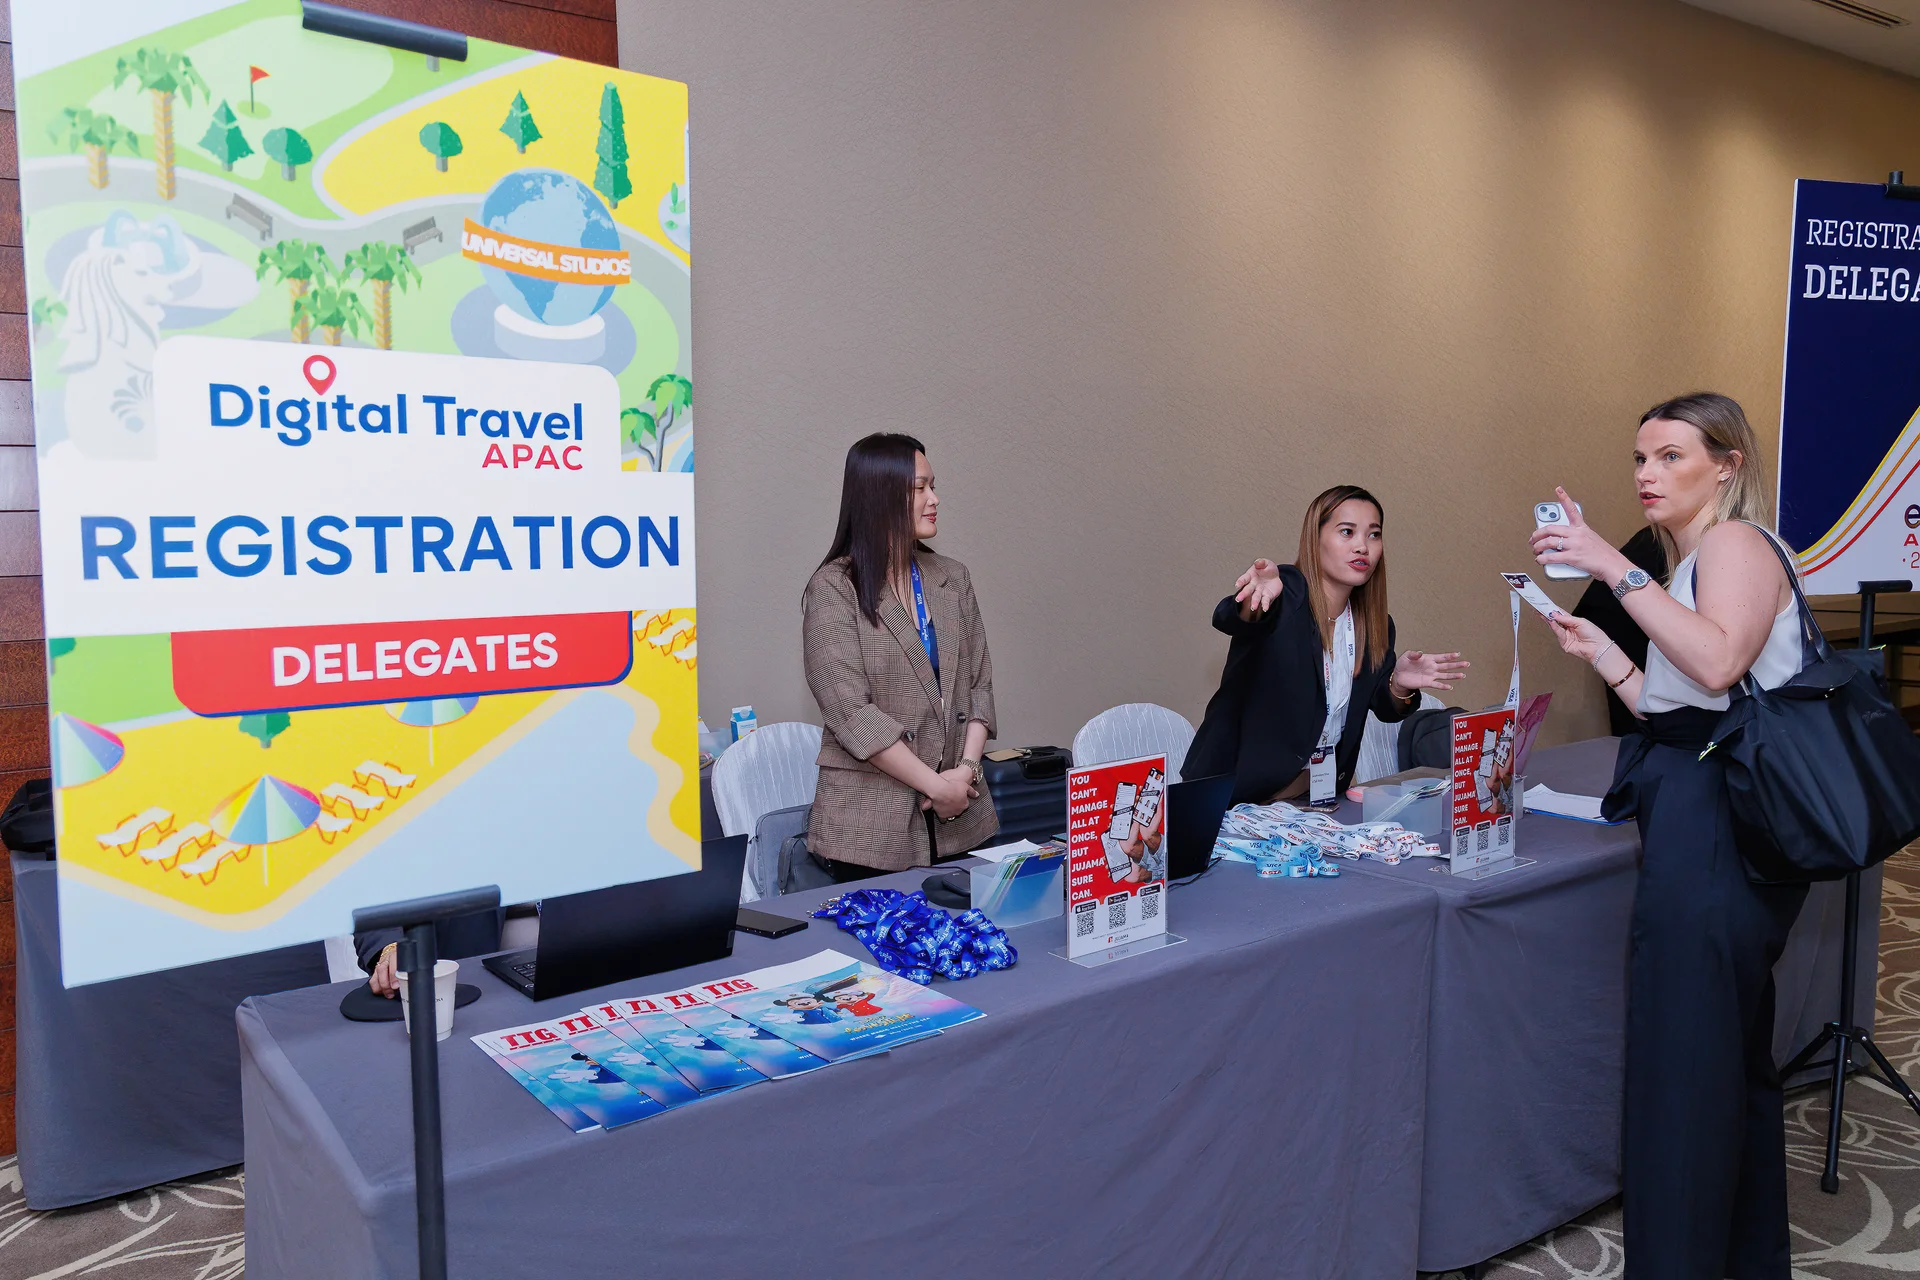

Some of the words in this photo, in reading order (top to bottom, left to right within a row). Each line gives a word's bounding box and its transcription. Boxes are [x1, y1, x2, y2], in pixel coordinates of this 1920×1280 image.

[461, 231, 559, 275] UNIVERSAL
[559, 252, 632, 277] STUDIOS
[209, 383, 408, 447] Digital
[422, 395, 584, 441] Travel
[482, 444, 583, 471] APAC
[81, 515, 680, 581] REGISTRATION
[272, 631, 559, 688] DELEGATES
[1455, 721, 1468, 730] YOU
[1455, 732, 1473, 742] CAN'T
[1455, 742, 1479, 754] MANAGE
[1455, 757, 1466, 766] ALL
[1466, 755, 1473, 764] AT
[1455, 768, 1472, 778] ONCE,
[1071, 775, 1090, 786] YOU
[1454, 780, 1466, 790] BUT
[1071, 787, 1098, 801] CAN'T
[1454, 791, 1476, 802] JUJAMA
[1071, 800, 1108, 815] MANAGE
[1454, 804, 1469, 814] SURE
[1071, 817, 1087, 830] ALL
[1088, 815, 1100, 826] AT
[1454, 816, 1468, 825] CAN.
[1071, 831, 1098, 844] ONCE,
[1071, 846, 1089, 859] BUT
[1071, 857, 1105, 873] JUJAMA
[1071, 873, 1094, 887] SURE
[1071, 888, 1093, 901] CAN.
[702, 979, 755, 997] TTG
[664, 993, 698, 1007] TT
[559, 1015, 595, 1032] TT
[500, 1028, 558, 1047] TTG
